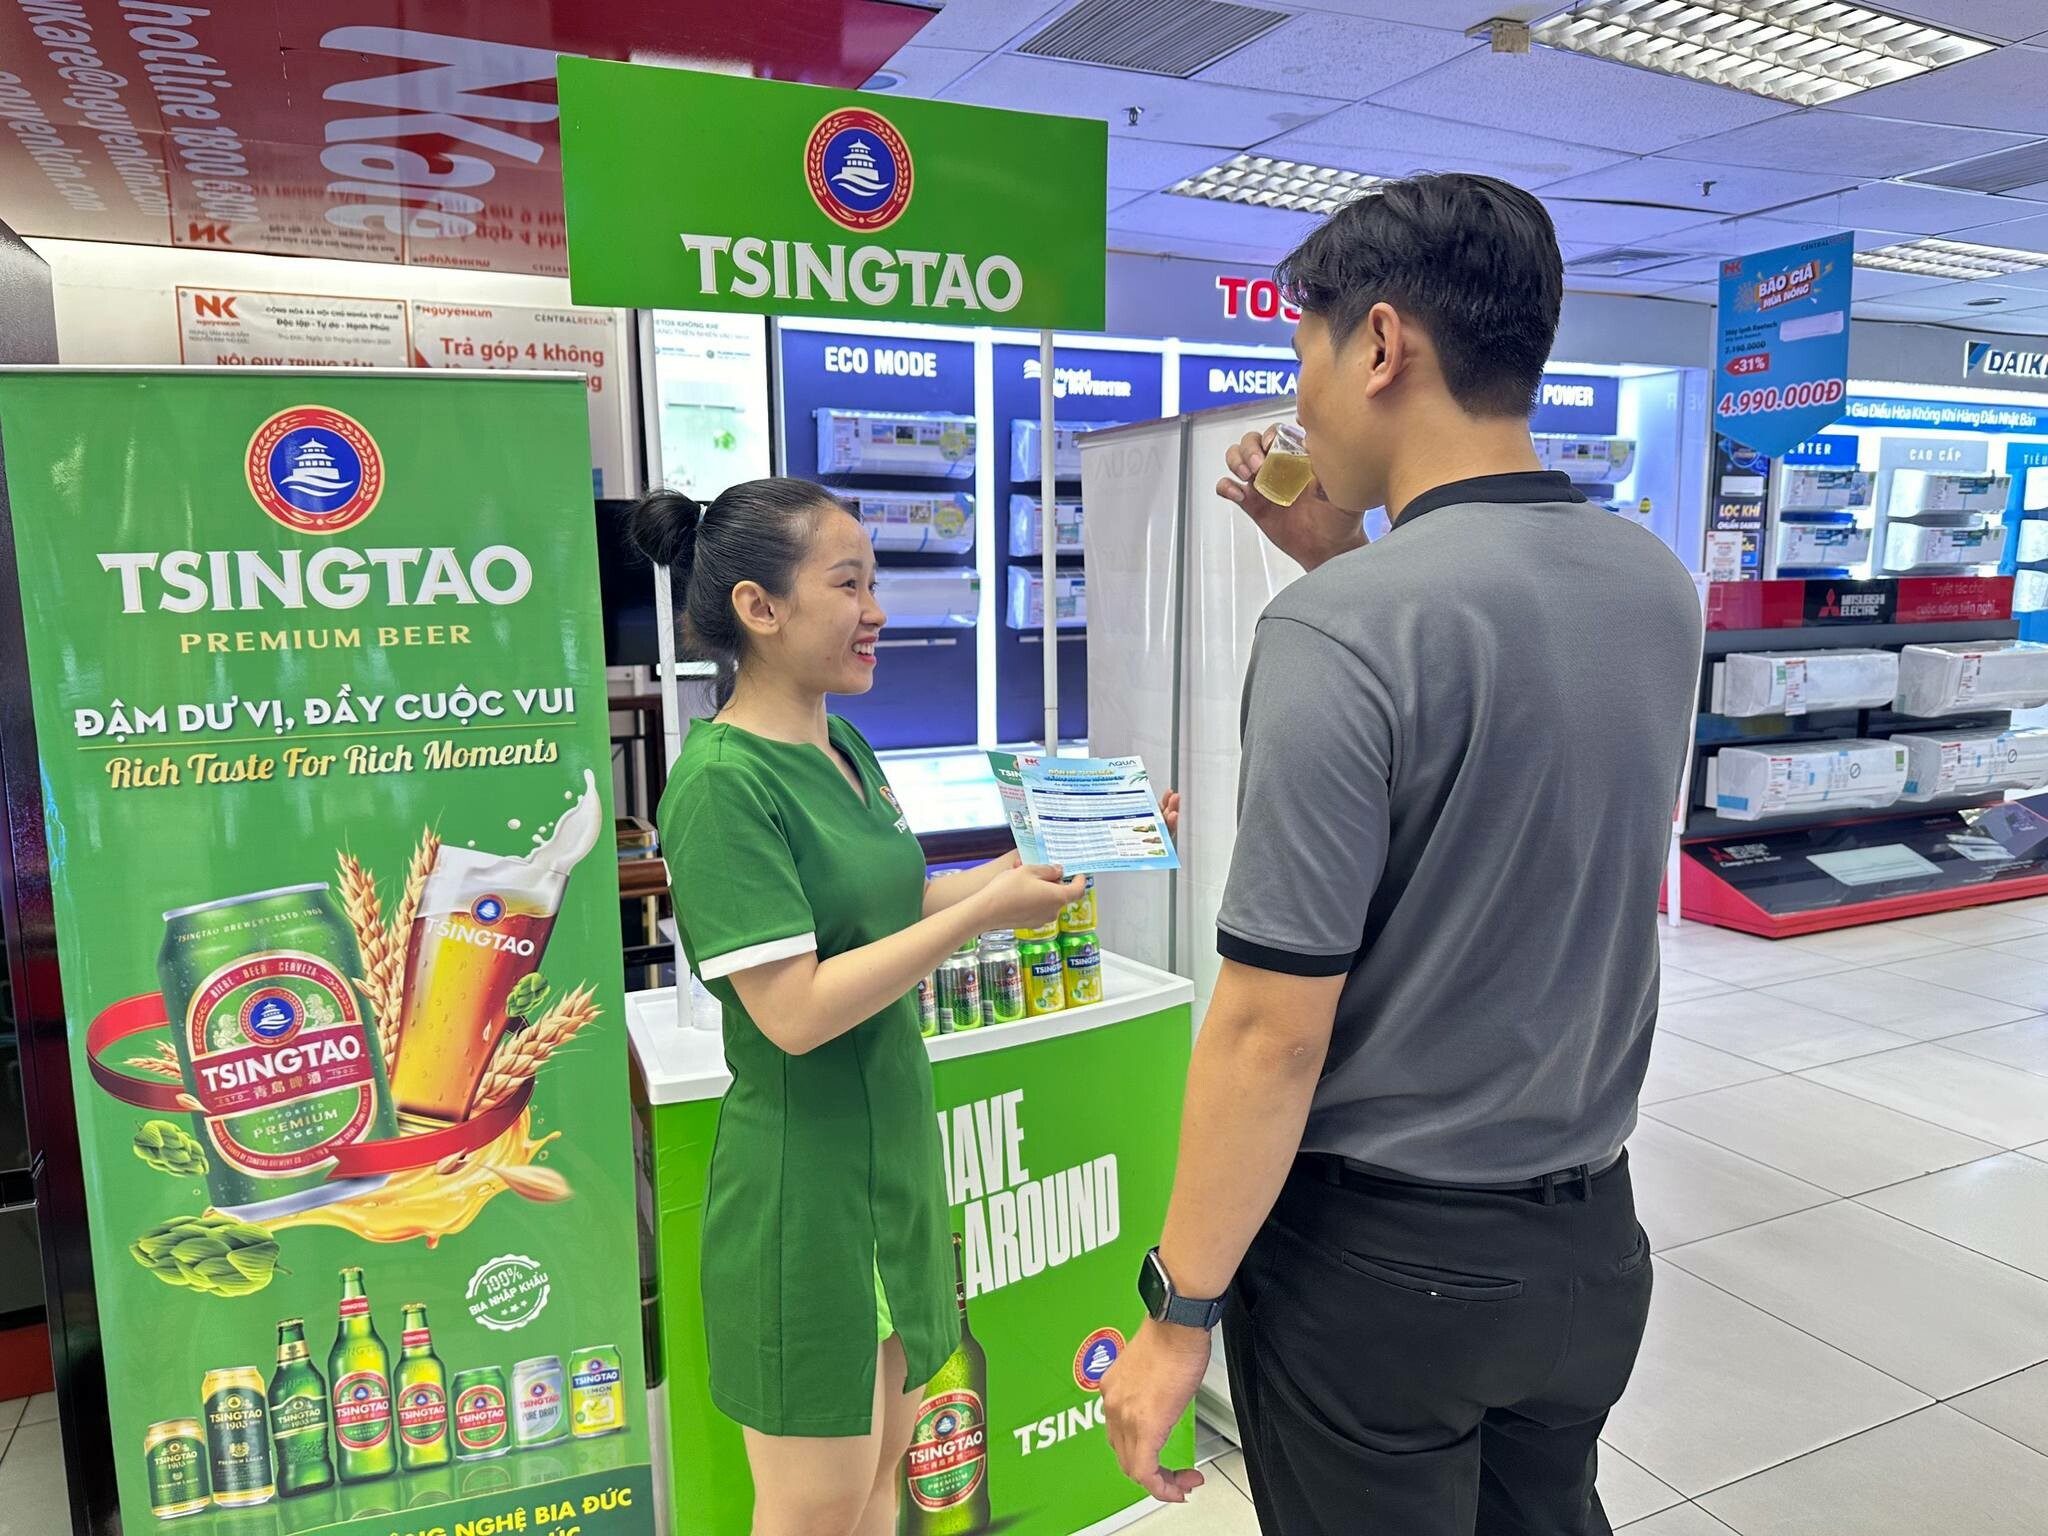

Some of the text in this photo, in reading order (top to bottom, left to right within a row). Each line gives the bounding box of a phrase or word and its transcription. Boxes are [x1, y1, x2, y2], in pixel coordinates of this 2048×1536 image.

[118, 0, 260, 223] hotline 1800 6800
[319, 26, 560, 239] NKare
[680, 233, 1023, 313] TSINGTAO
[194, 294, 239, 318] NK
[276, 318, 293, 327] Độc
[440, 336, 605, 367] Trả góp 4 không
[824, 346, 938, 378] ECO MODE
[1733, 357, 1766, 373] -31%
[1542, 384, 1594, 407] POWER
[1717, 379, 1844, 418] 4.990.000Đ
[1852, 403, 1868, 417] Gia
[1910, 449, 1932, 461] CAO
[1719, 501, 1762, 520] LỌC KHÍ
[96, 544, 533, 614] TSINGTAO
[180, 624, 472, 654] PREMIUM BEER
[74, 683, 576, 743] ĐẬM DƯ VỊ, ĐẦY CUỘC VUI
[105, 737, 559, 789] Rich Taste For Rich Moments
[1108, 760, 1137, 768] AQUA
[178, 928, 220, 943] TSINGTAO
[426, 917, 535, 956] TSINGTAO
[242, 963, 267, 978] BEER
[278, 961, 318, 977] CERVEZA
[201, 1035, 361, 1092] TSINGTAO
[253, 1108, 338, 1138] PREMIUM
[272, 1125, 326, 1145] LAGER
[964, 1153, 1120, 1301] AROUND
[483, 1266, 523, 1295] 100%
[468, 1271, 549, 1316] BIA NHẬP KHẨU
[574, 1371, 617, 1386] TSINGTAO
[336, 1400, 389, 1418] TSINGTAO
[400, 1405, 445, 1420] TSINGTAO
[520, 1394, 560, 1408] TSINGTAO
[209, 1409, 262, 1423] TSINGTAO
[278, 1409, 320, 1424] TSINGTAO
[459, 1409, 504, 1424] TSINGTAO
[154, 1451, 197, 1466] TSINGTAO
[909, 1430, 983, 1465] TSINGTAO
[454, 1487, 632, 1536] NGHỆ BIA ĐỨC
